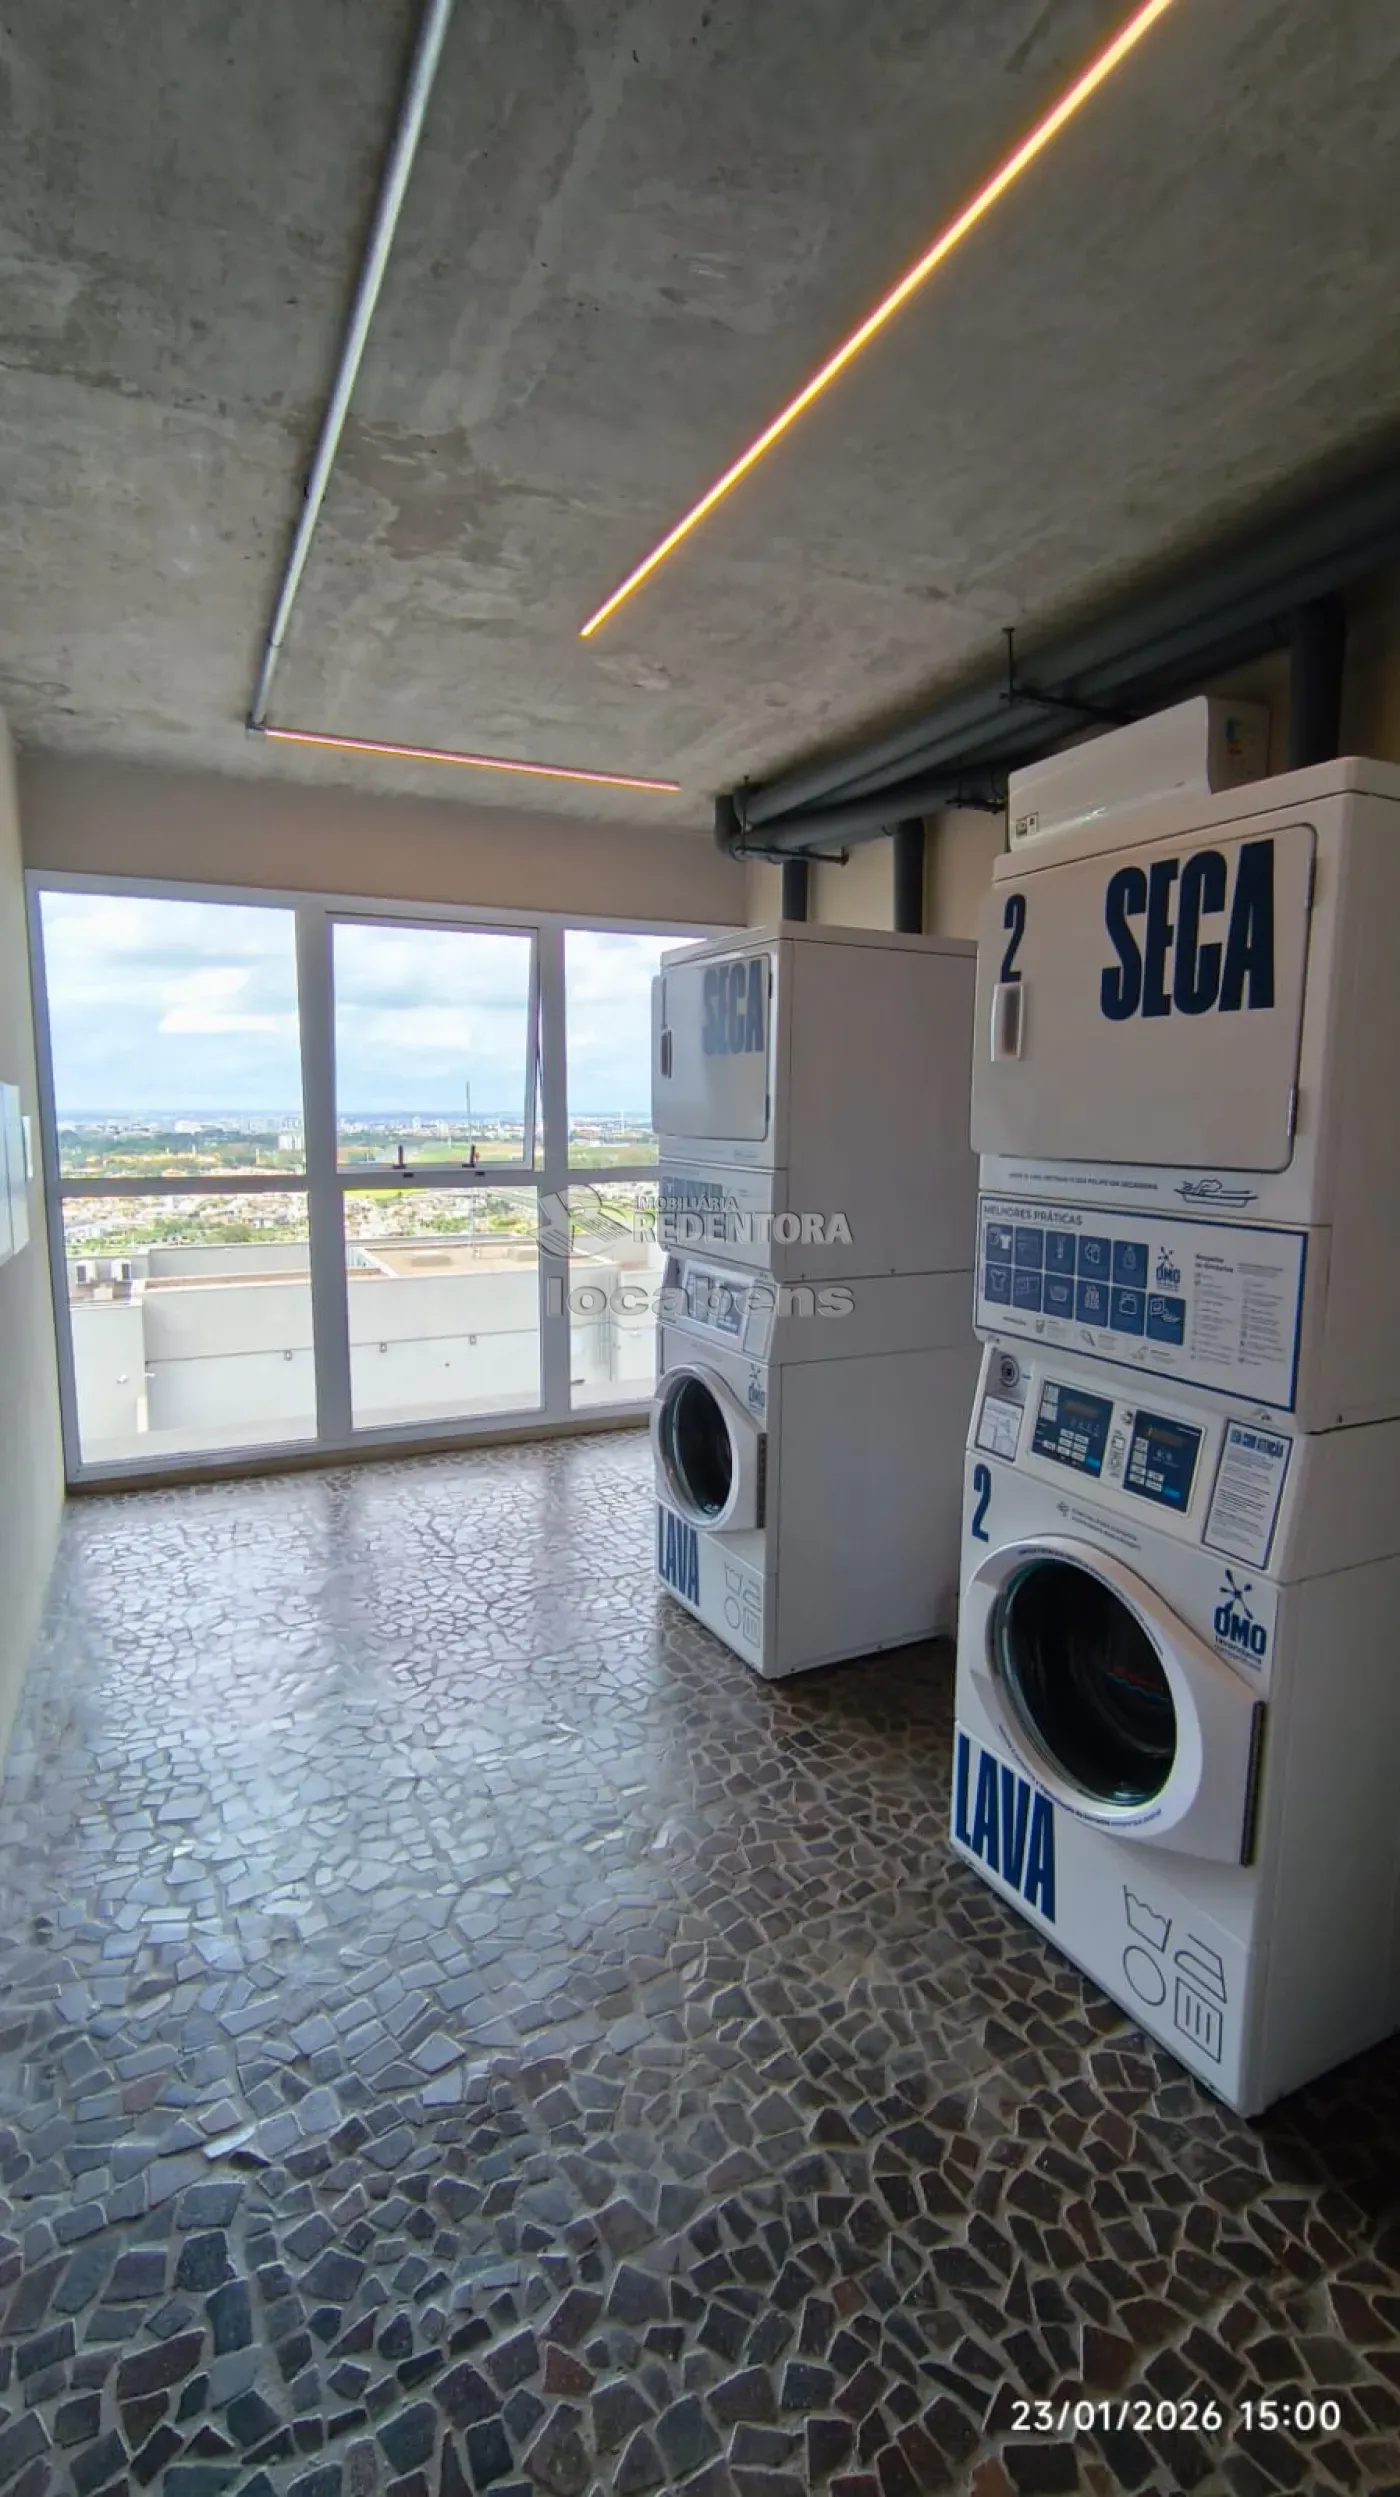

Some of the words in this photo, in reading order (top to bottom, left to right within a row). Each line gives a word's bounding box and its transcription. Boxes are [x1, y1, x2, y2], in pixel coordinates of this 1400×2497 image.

[1000, 893, 1027, 984] 2
[1101, 838, 1275, 1021] SECA
[702, 958, 765, 1056] SECA
[1033, 1207, 1084, 1227] PRÁTICAS
[1155, 1264, 1181, 1284] OMO
[971, 1463, 992, 1543] 2
[658, 1504, 700, 1608] LAVA
[1213, 1603, 1267, 1655] OMO
[955, 1731, 1057, 1925] LAVA
